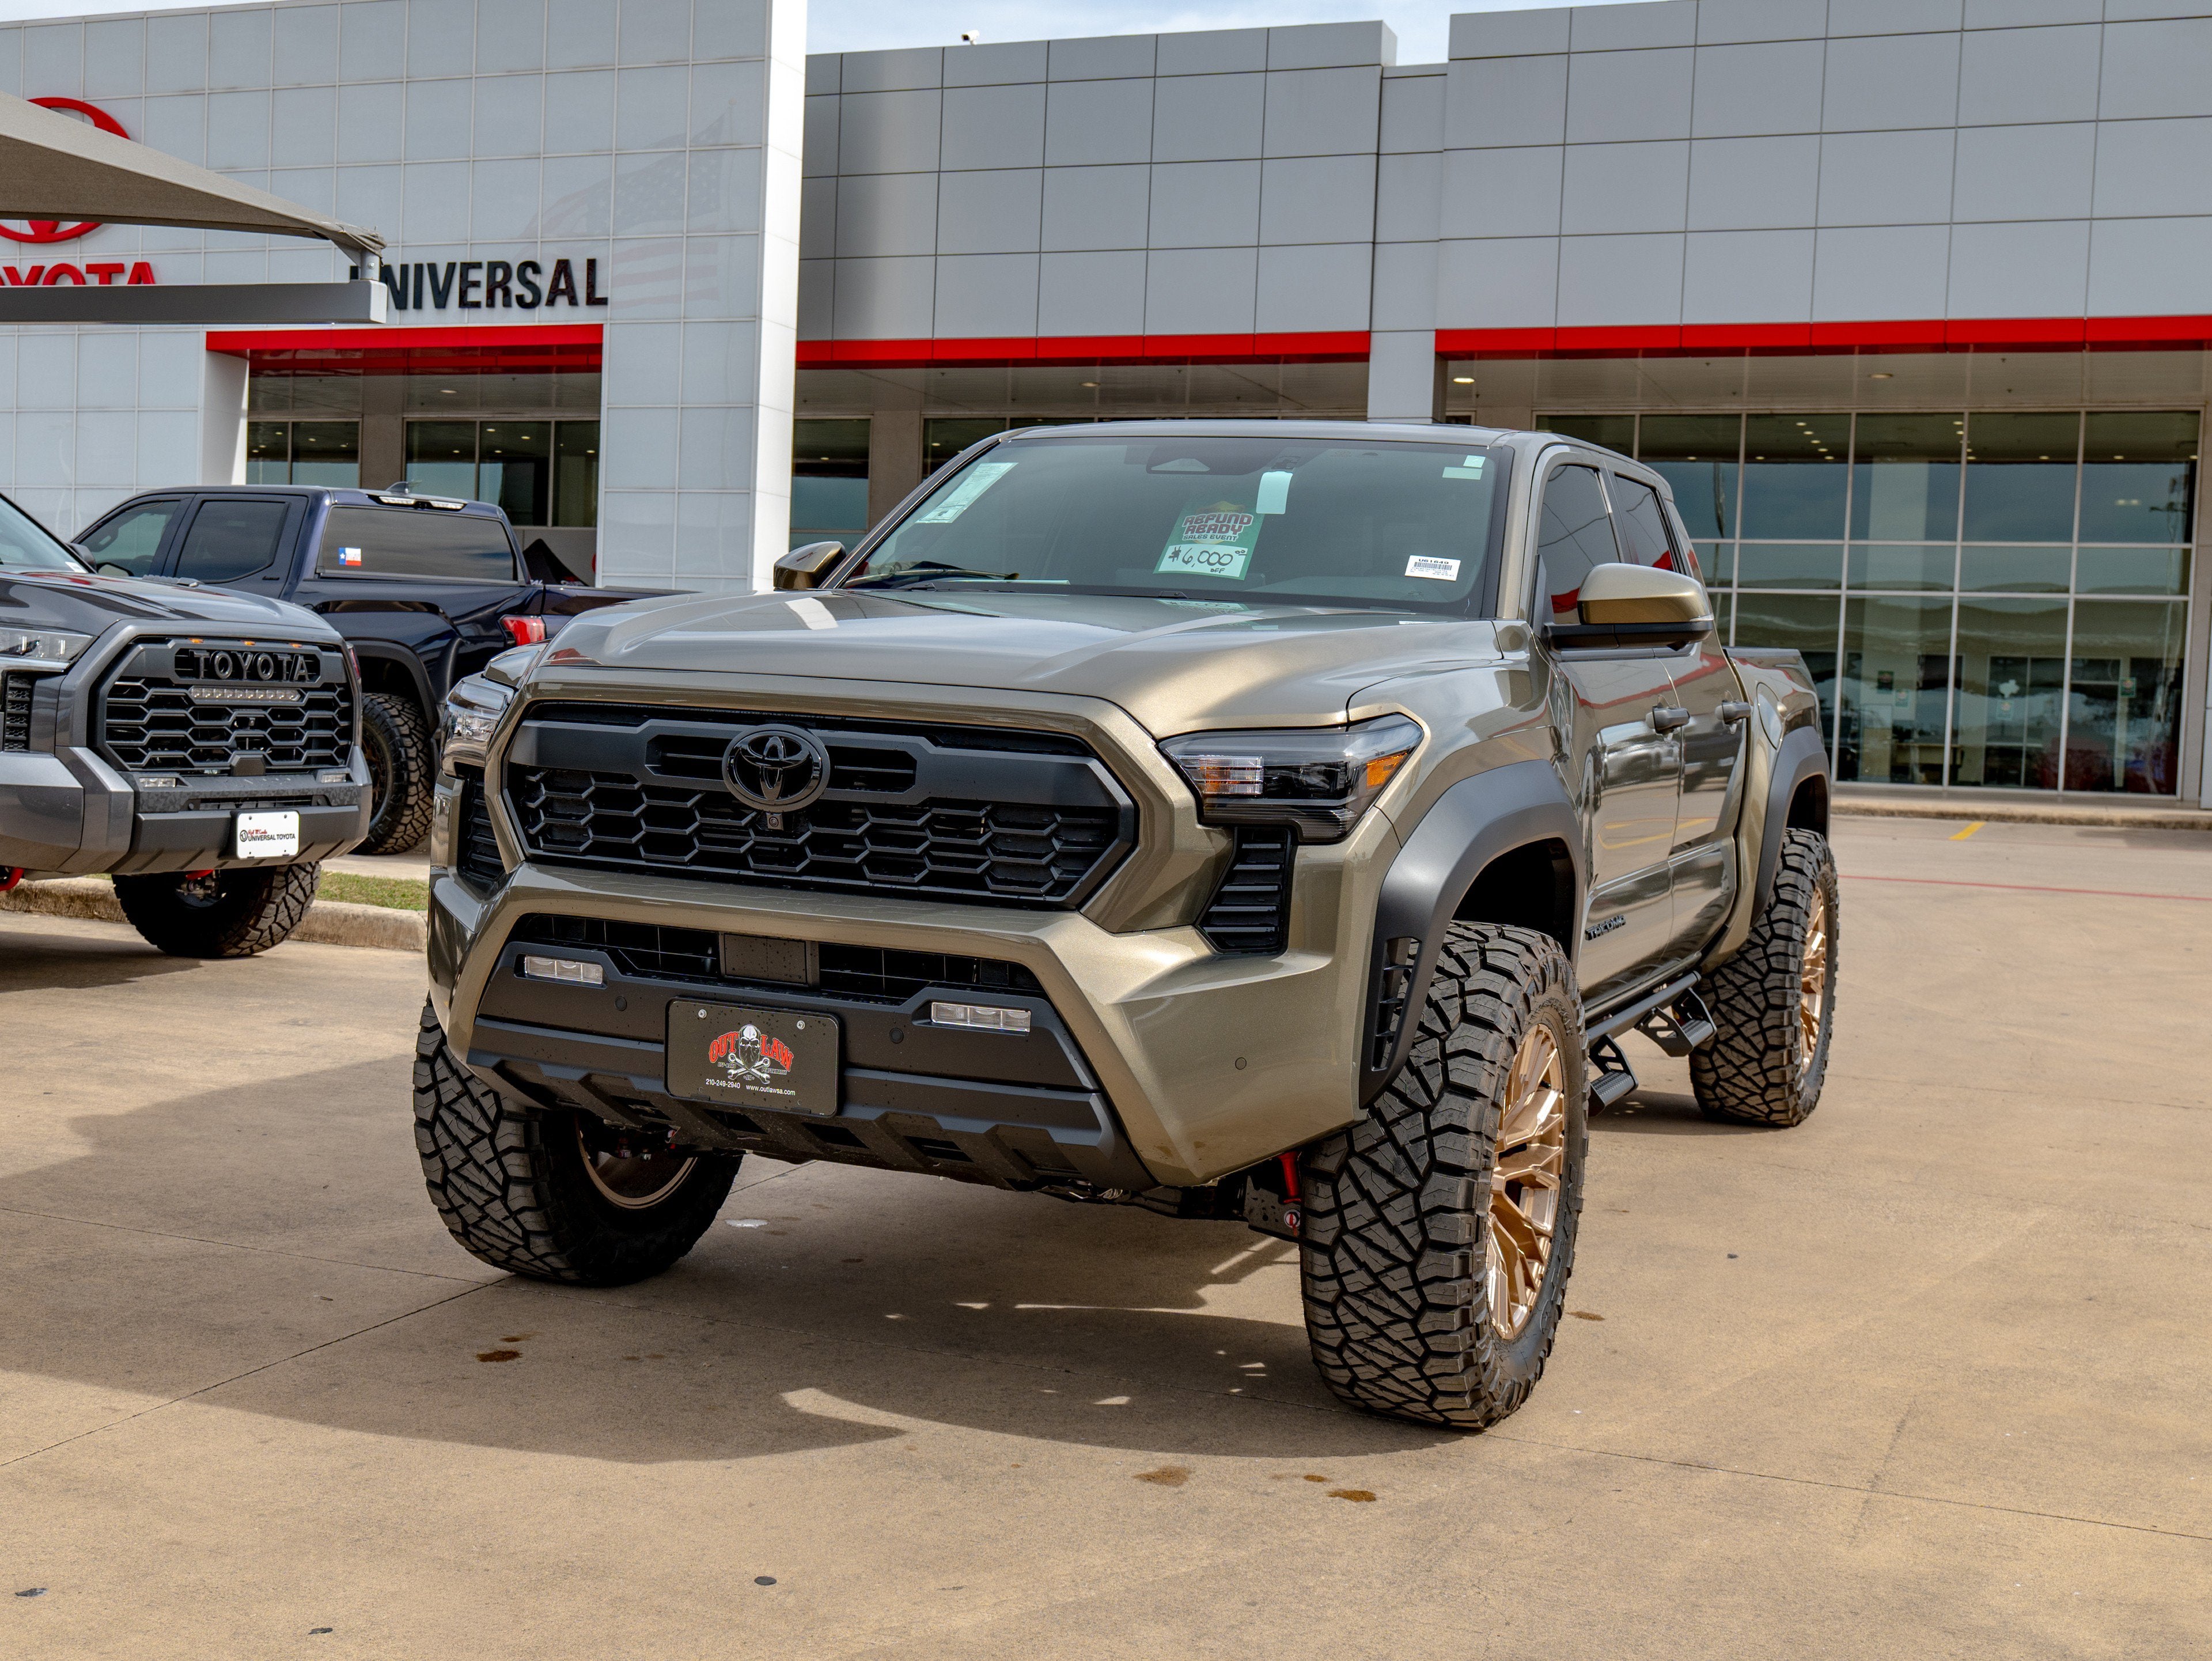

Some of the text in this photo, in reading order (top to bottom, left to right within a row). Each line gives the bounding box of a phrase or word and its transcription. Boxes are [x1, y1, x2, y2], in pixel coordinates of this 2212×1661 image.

[350, 258, 608, 310] NIVERSAL
[1183, 513, 1253, 527] REFUND
[1184, 523, 1244, 535] READY
[189, 649, 310, 682] TOYOTA
[706, 1078, 796, 1096] 210-249-2940 www.outlawsa.com
